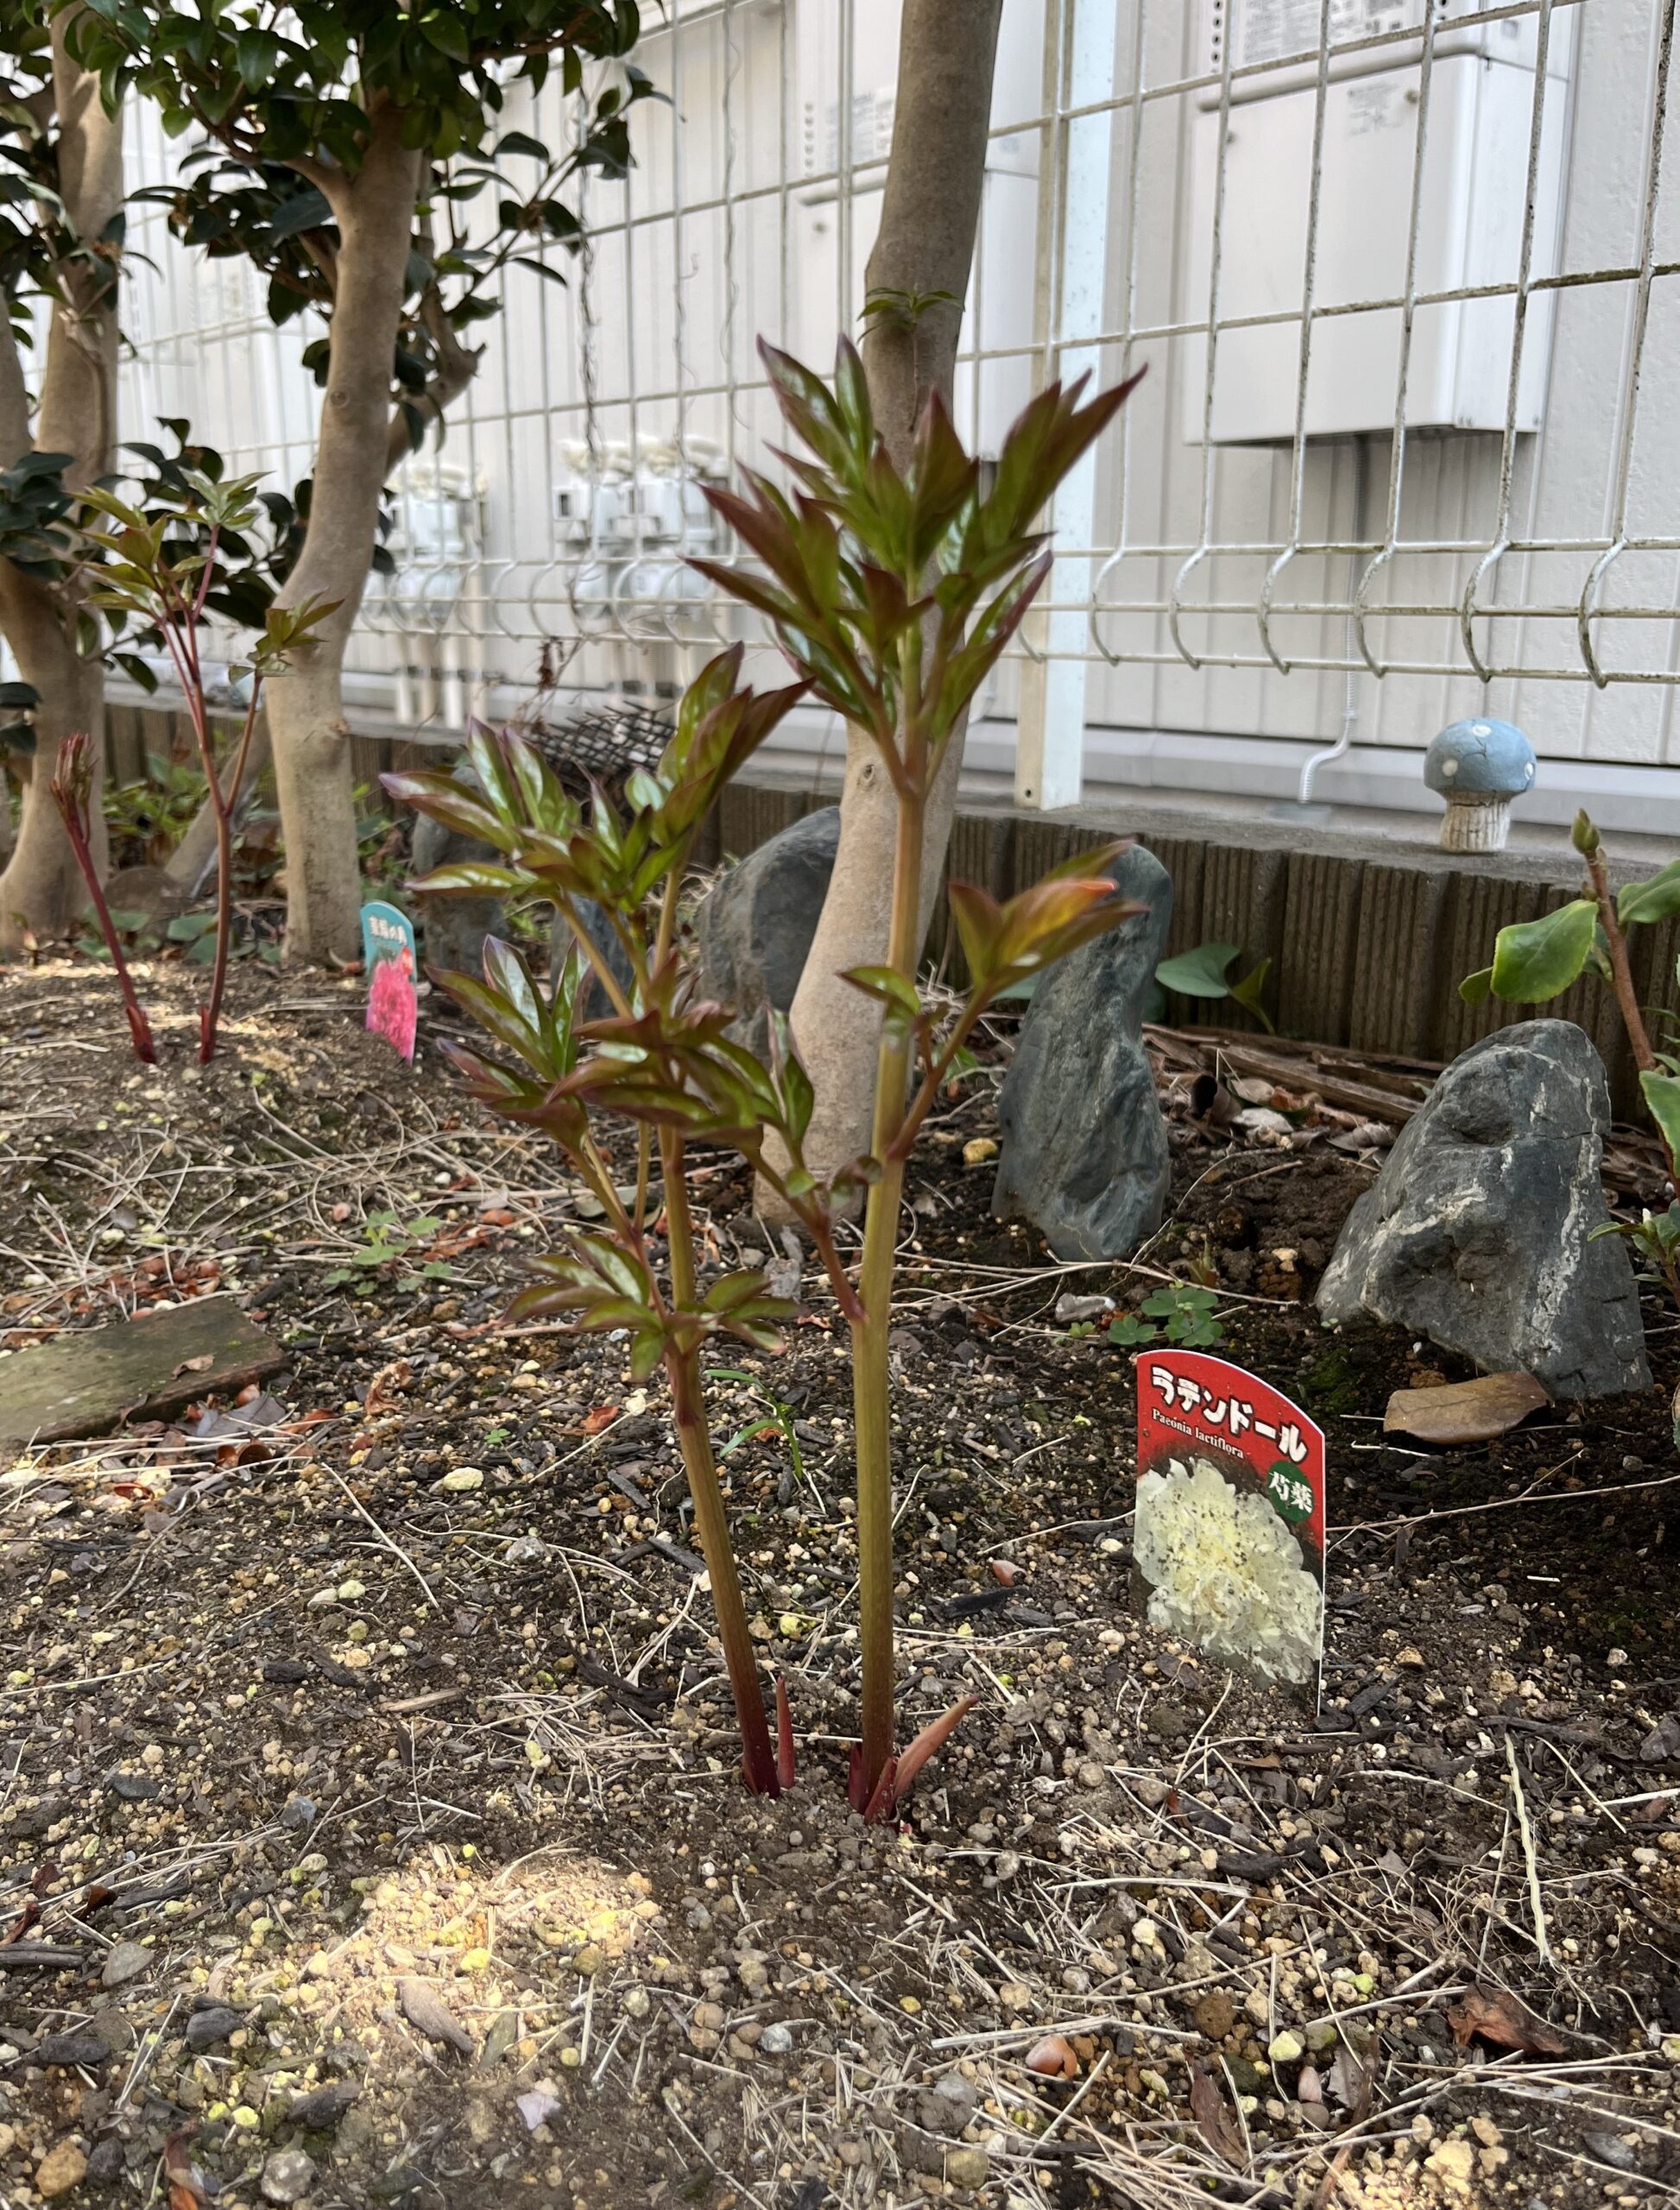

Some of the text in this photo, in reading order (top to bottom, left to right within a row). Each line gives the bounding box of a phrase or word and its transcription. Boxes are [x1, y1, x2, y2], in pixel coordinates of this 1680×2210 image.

[1151, 1365, 1309, 1463] ラテンドール
[1152, 1408, 1244, 1459] Paeonia lactiflora
[1268, 1471, 1313, 1513] 芍薬
